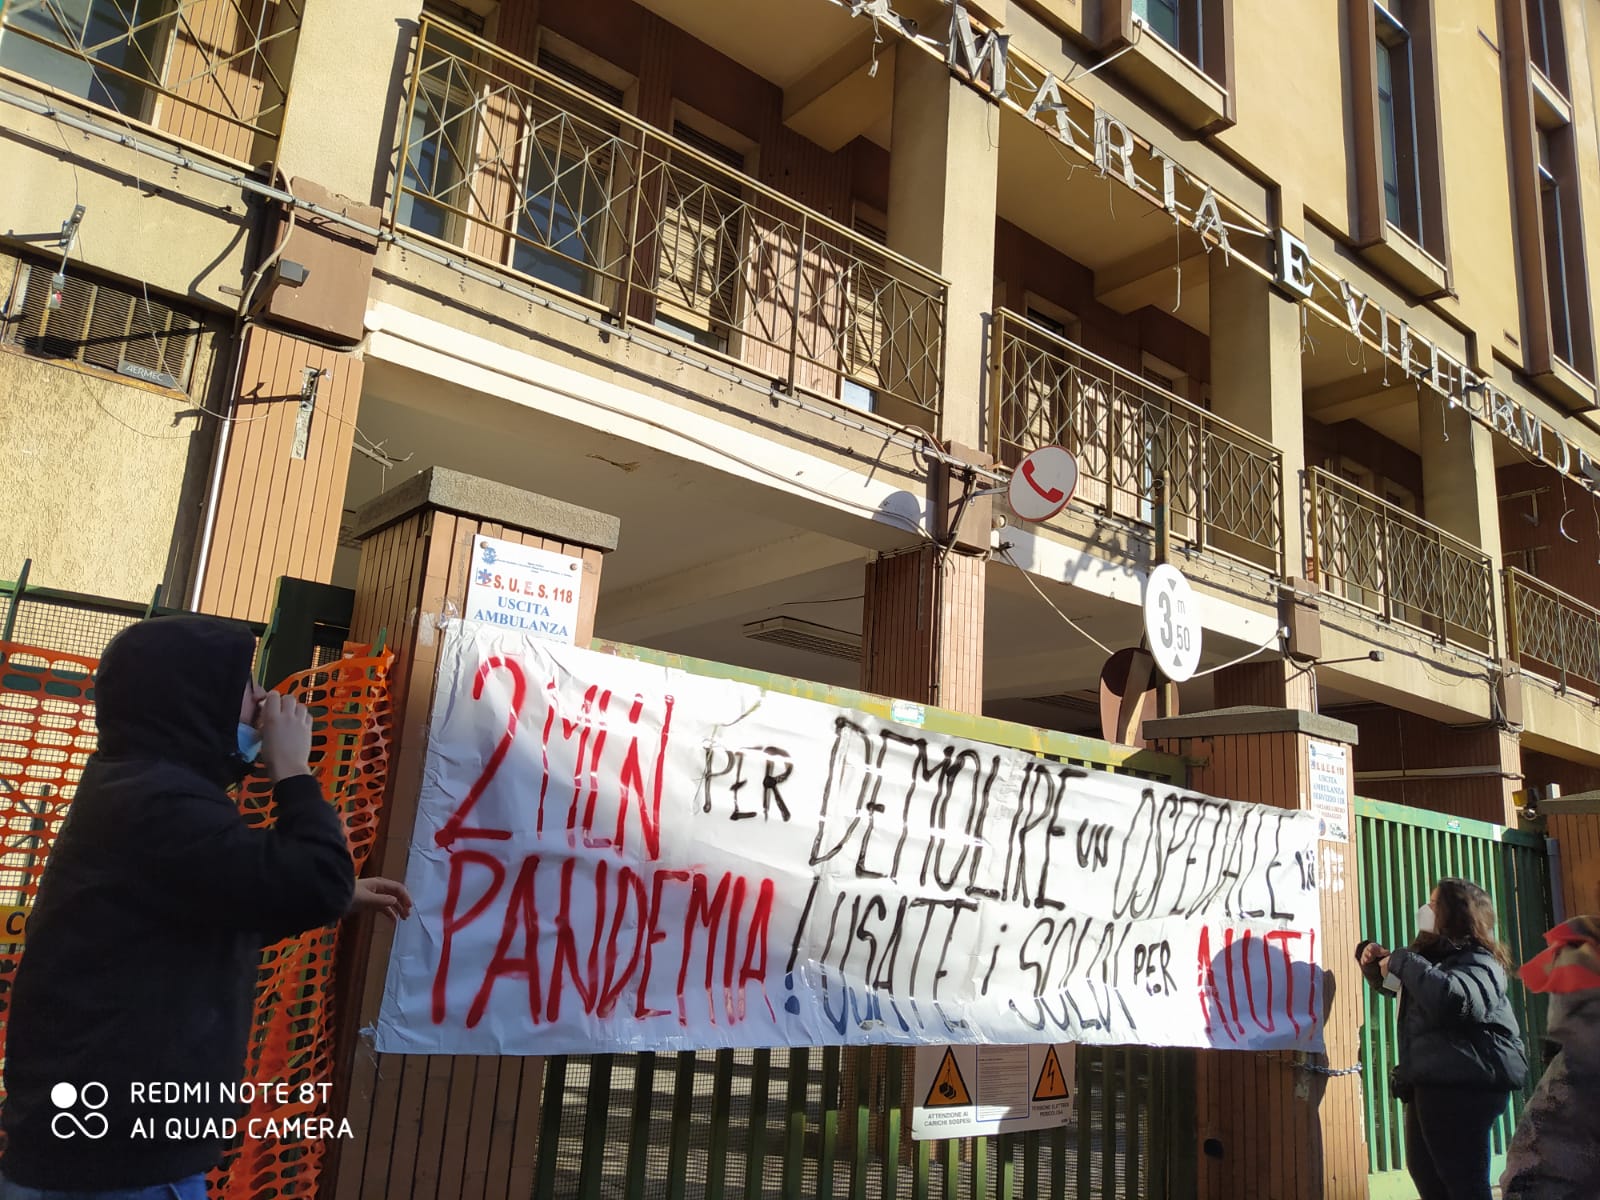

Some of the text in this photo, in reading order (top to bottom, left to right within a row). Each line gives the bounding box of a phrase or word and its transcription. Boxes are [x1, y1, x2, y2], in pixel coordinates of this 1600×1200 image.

[1276, 229, 1314, 298] E
[126, 364, 163, 381] AERMEC
[498, 596, 550, 617] USCITA
[552, 587, 573, 603] 118
[474, 608, 568, 636] AMBULANZA
[434, 655, 527, 850] 2
[537, 681, 675, 860] MIN
[700, 744, 794, 822] PER
[809, 716, 1088, 908] DEMOLIRE
[1113, 787, 1297, 920] OSPEDALE
[819, 891, 978, 1035] USATE
[1009, 917, 1137, 1033] SOLDI
[1133, 940, 1178, 997] PER
[928, 1111, 962, 1119] ATTENZIONE
